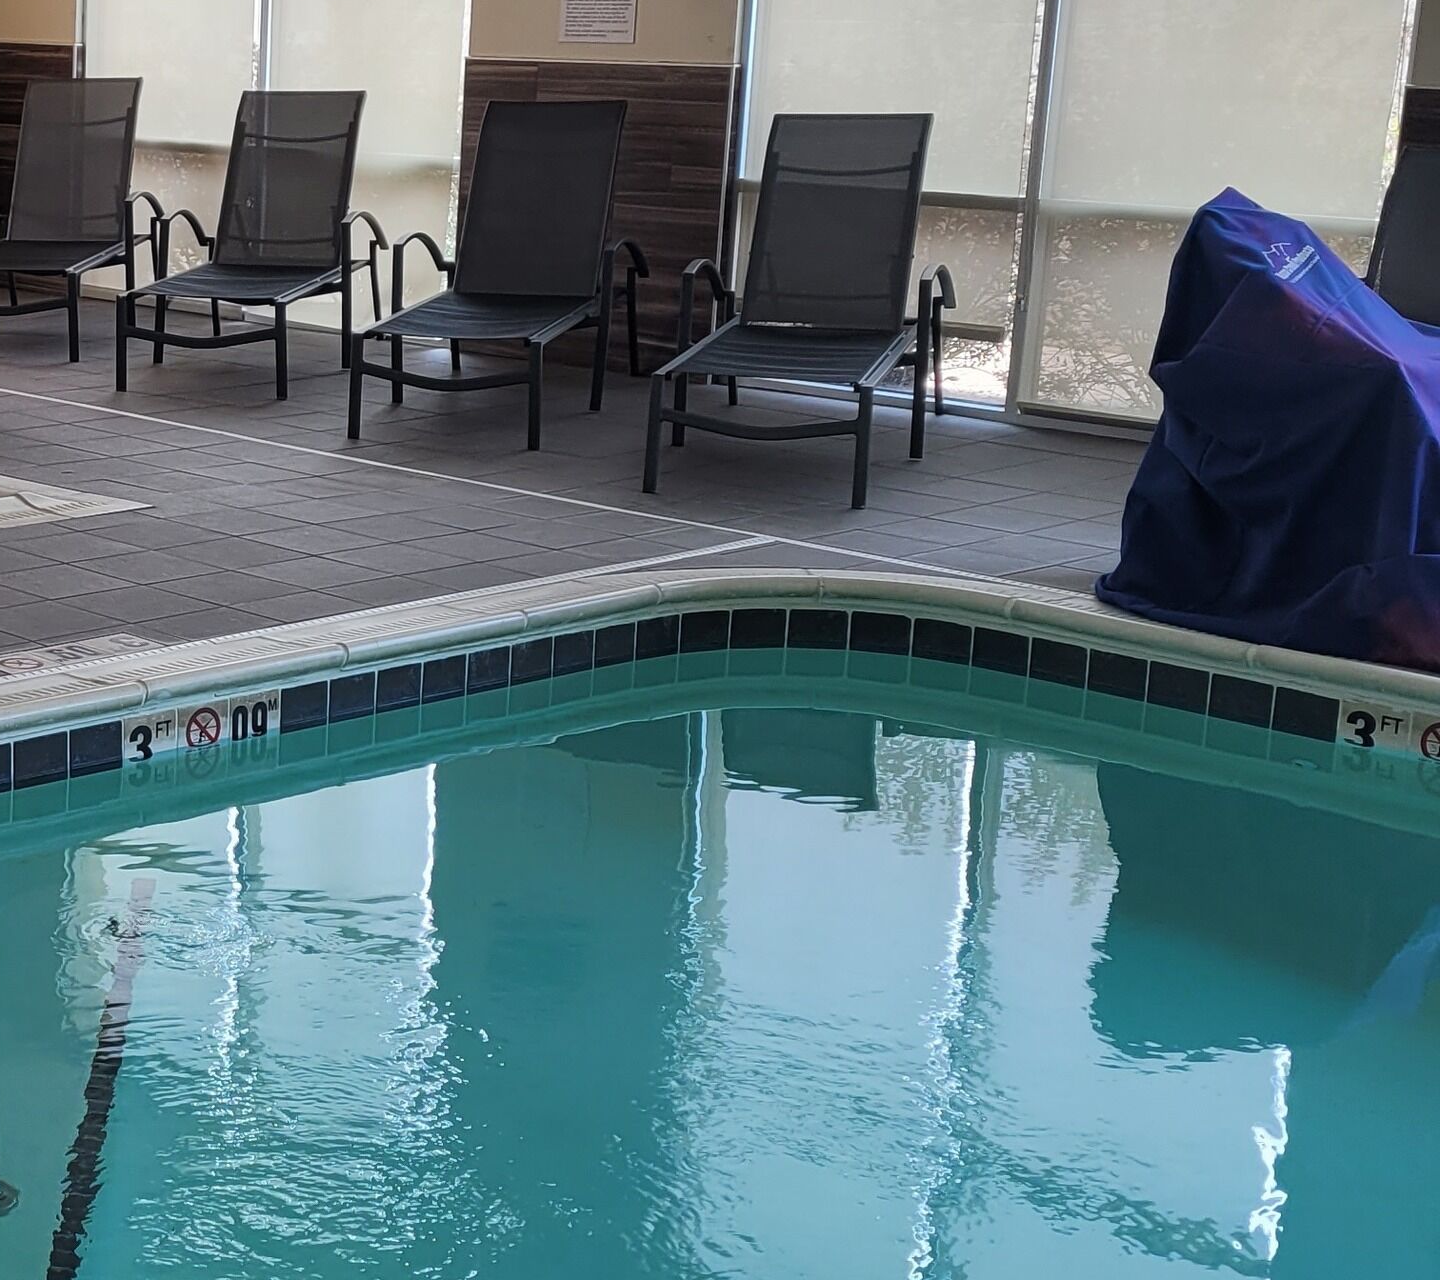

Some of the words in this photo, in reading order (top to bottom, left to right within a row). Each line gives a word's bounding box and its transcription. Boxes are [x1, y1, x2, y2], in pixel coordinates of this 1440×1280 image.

[128, 725, 153, 762] 3
[155, 720, 172, 738] FT
[1344, 711, 1376, 747] 3
[1381, 715, 1404, 734] FT
